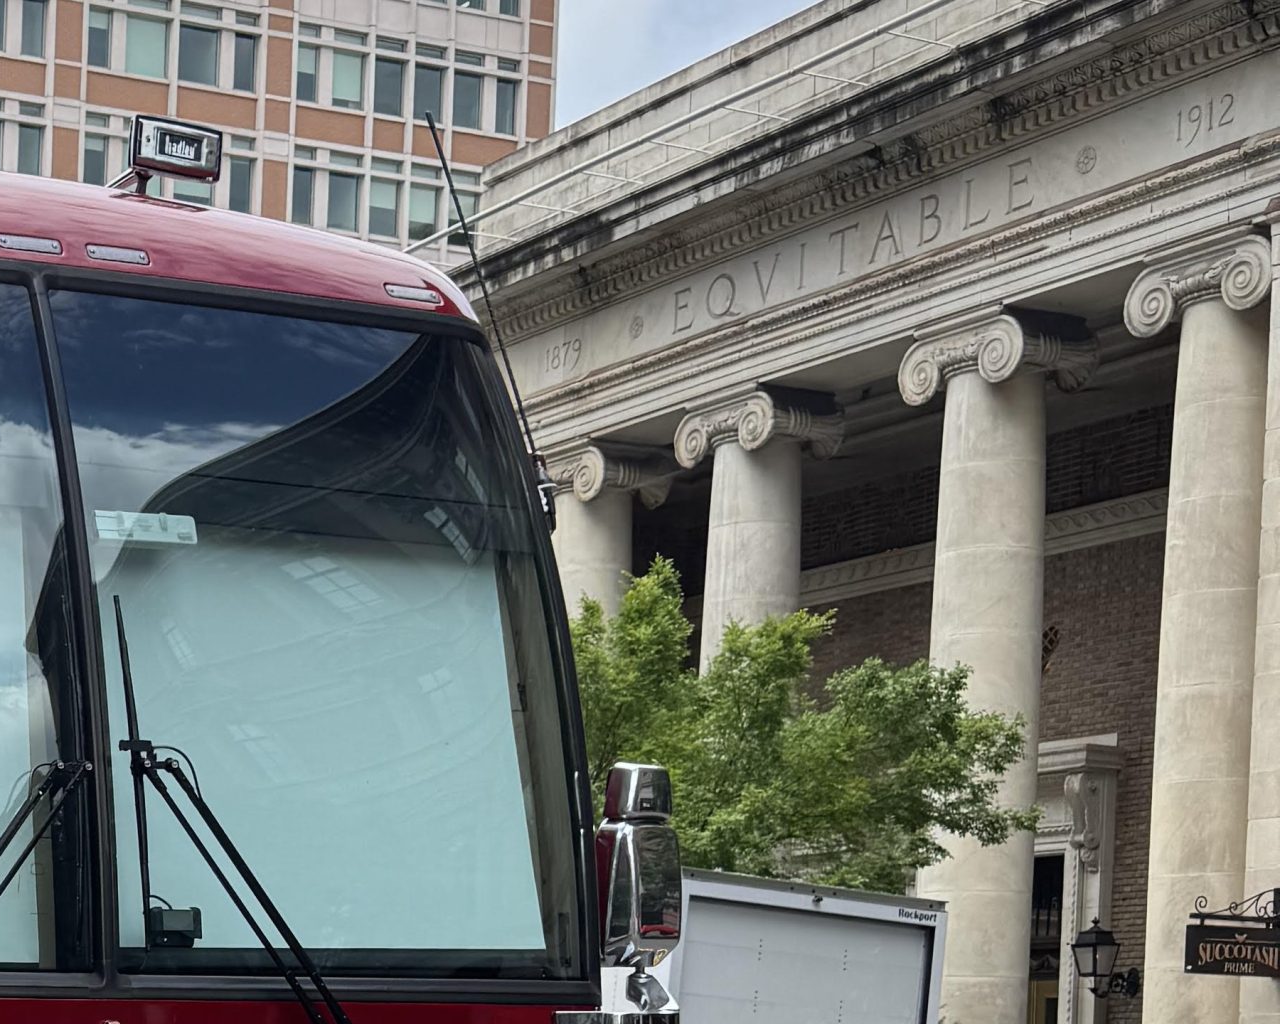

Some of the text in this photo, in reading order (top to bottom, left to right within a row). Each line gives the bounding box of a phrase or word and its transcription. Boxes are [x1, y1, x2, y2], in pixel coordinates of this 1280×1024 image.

[1176, 92, 1234, 149] 1912
[164, 134, 195, 160] hadley
[671, 156, 1035, 336] EQVITABLE
[545, 338, 582, 373] 1879
[898, 907, 937, 922] Rockport
[1198, 942, 1280, 970] SUCCOTASH
[1224, 961, 1255, 974] PRIME
